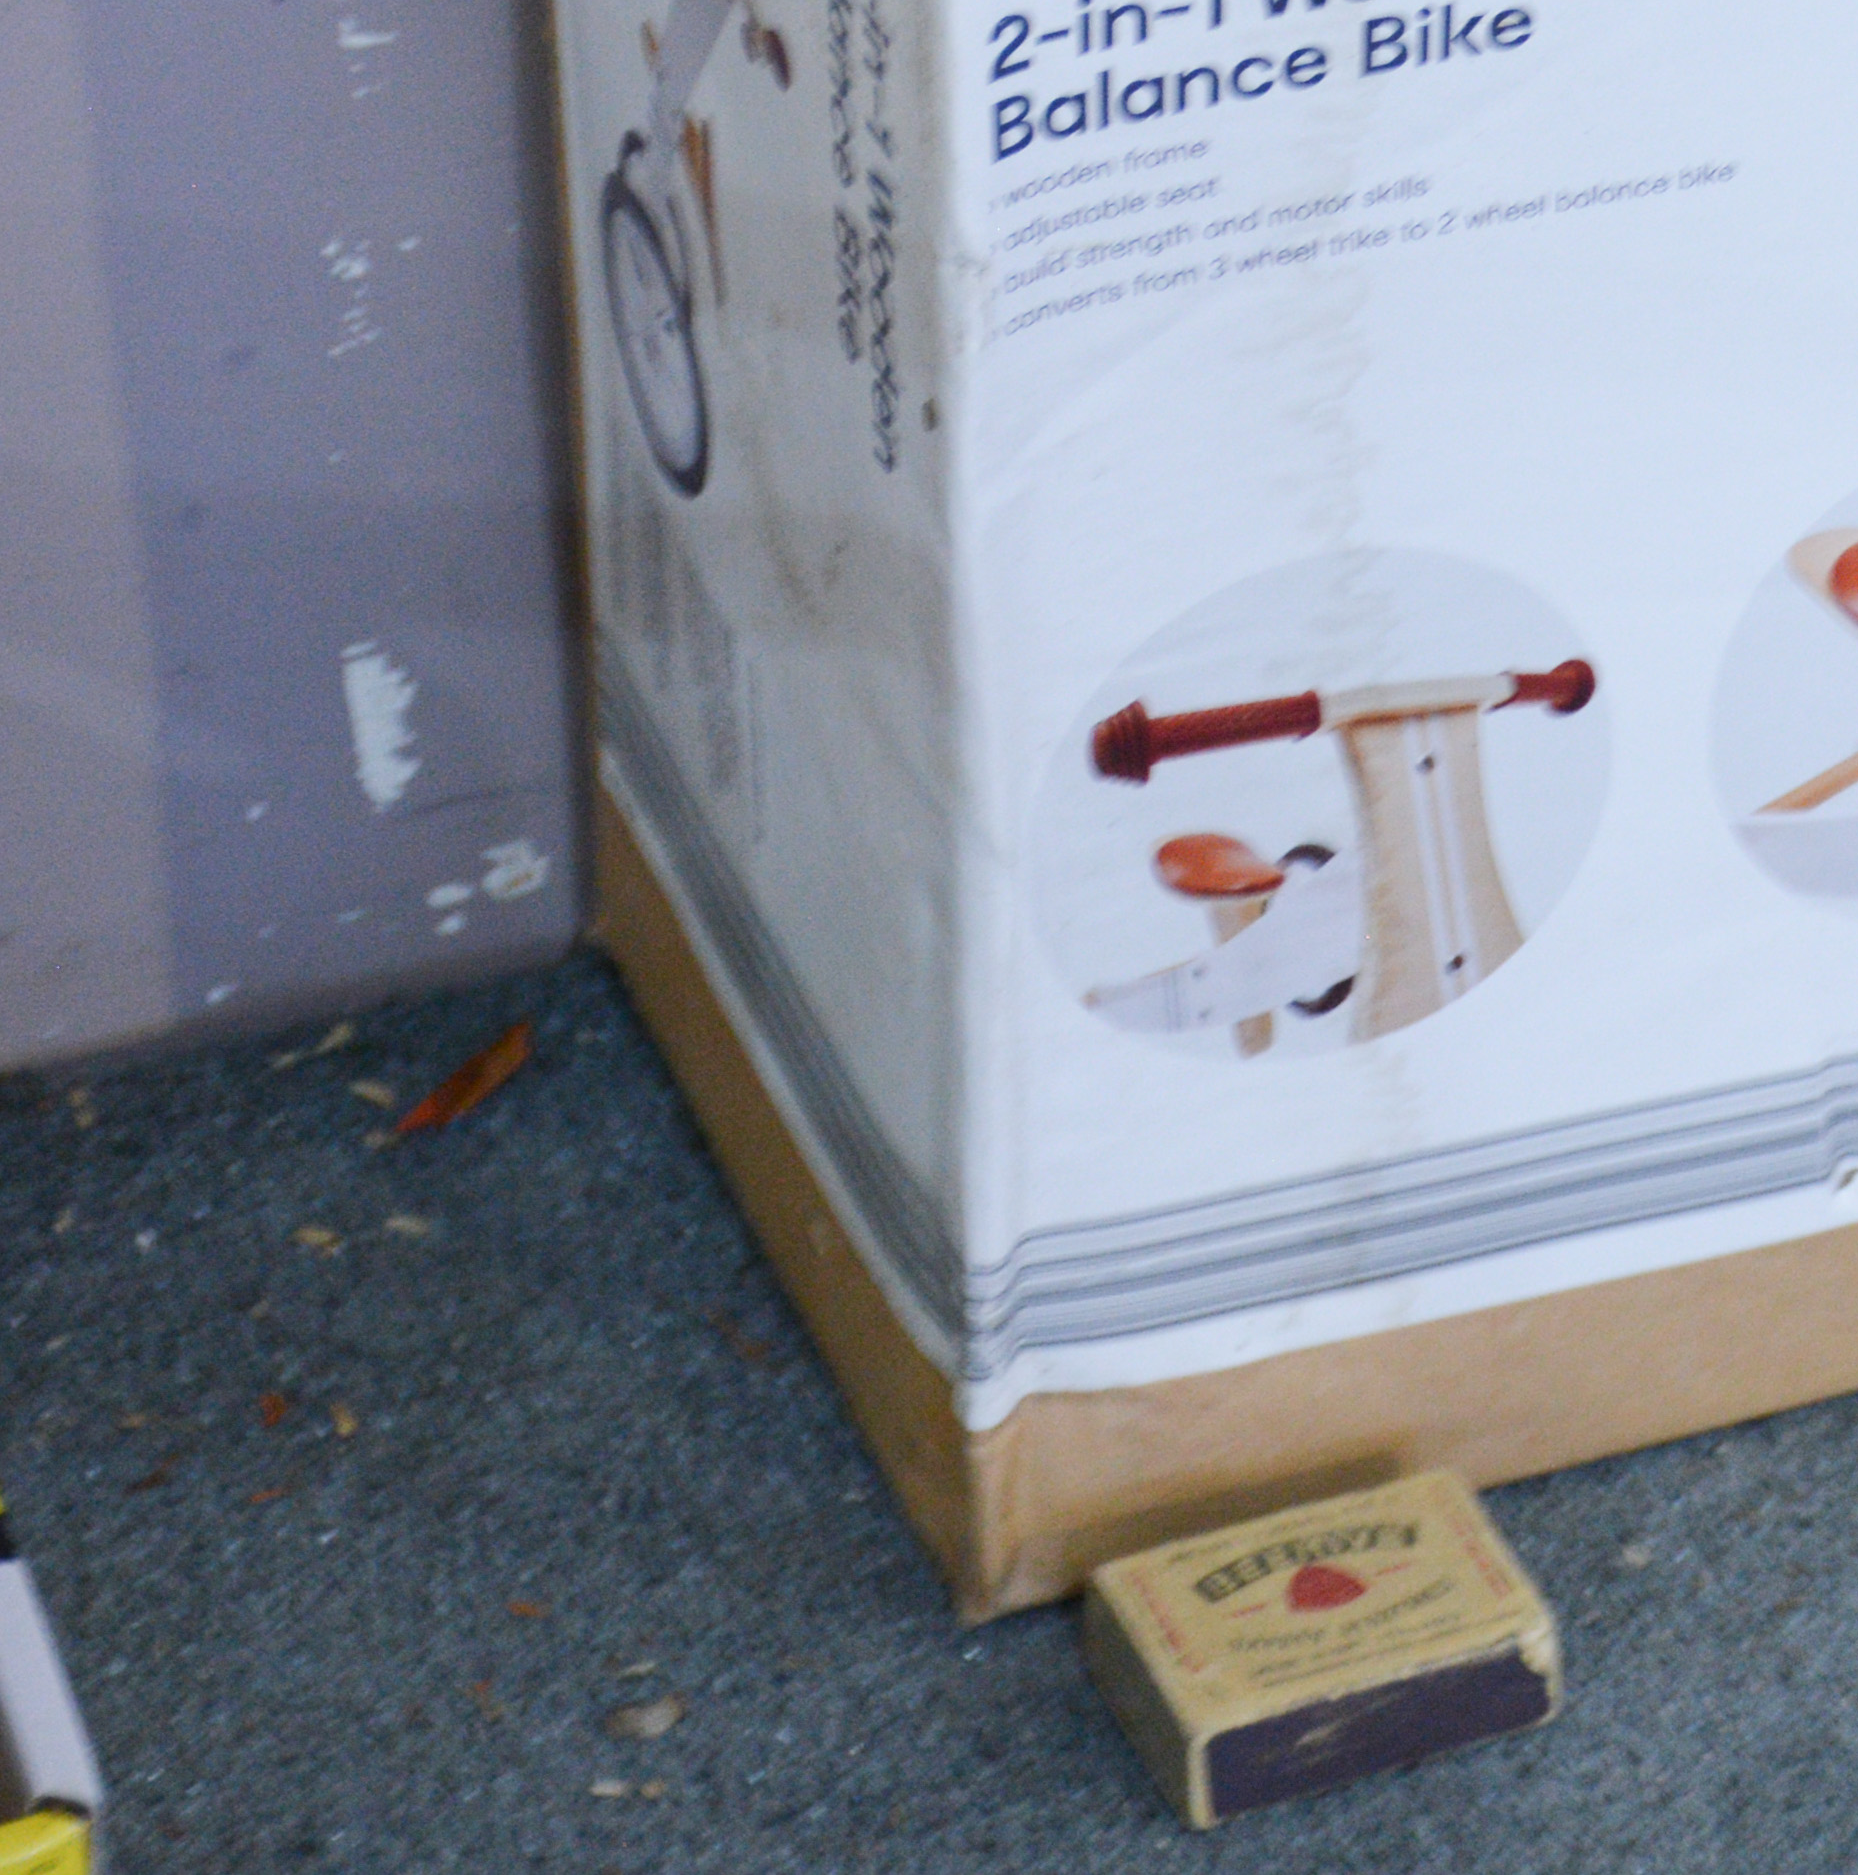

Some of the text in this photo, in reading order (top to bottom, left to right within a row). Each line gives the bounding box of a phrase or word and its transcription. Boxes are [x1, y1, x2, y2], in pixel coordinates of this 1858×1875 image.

[988, 3, 1536, 163] Balance Bike
[1003, 138, 1211, 209] wooden frame
[1003, 176, 1221, 252] adjustable seat
[1076, 223, 1195, 270] strength
[1203, 206, 1263, 240] and
[1266, 192, 1356, 228] motor
[1361, 172, 1433, 209] skills
[1003, 160, 1740, 337] converts from 3 wheel trike to 2 wheel balance bike
